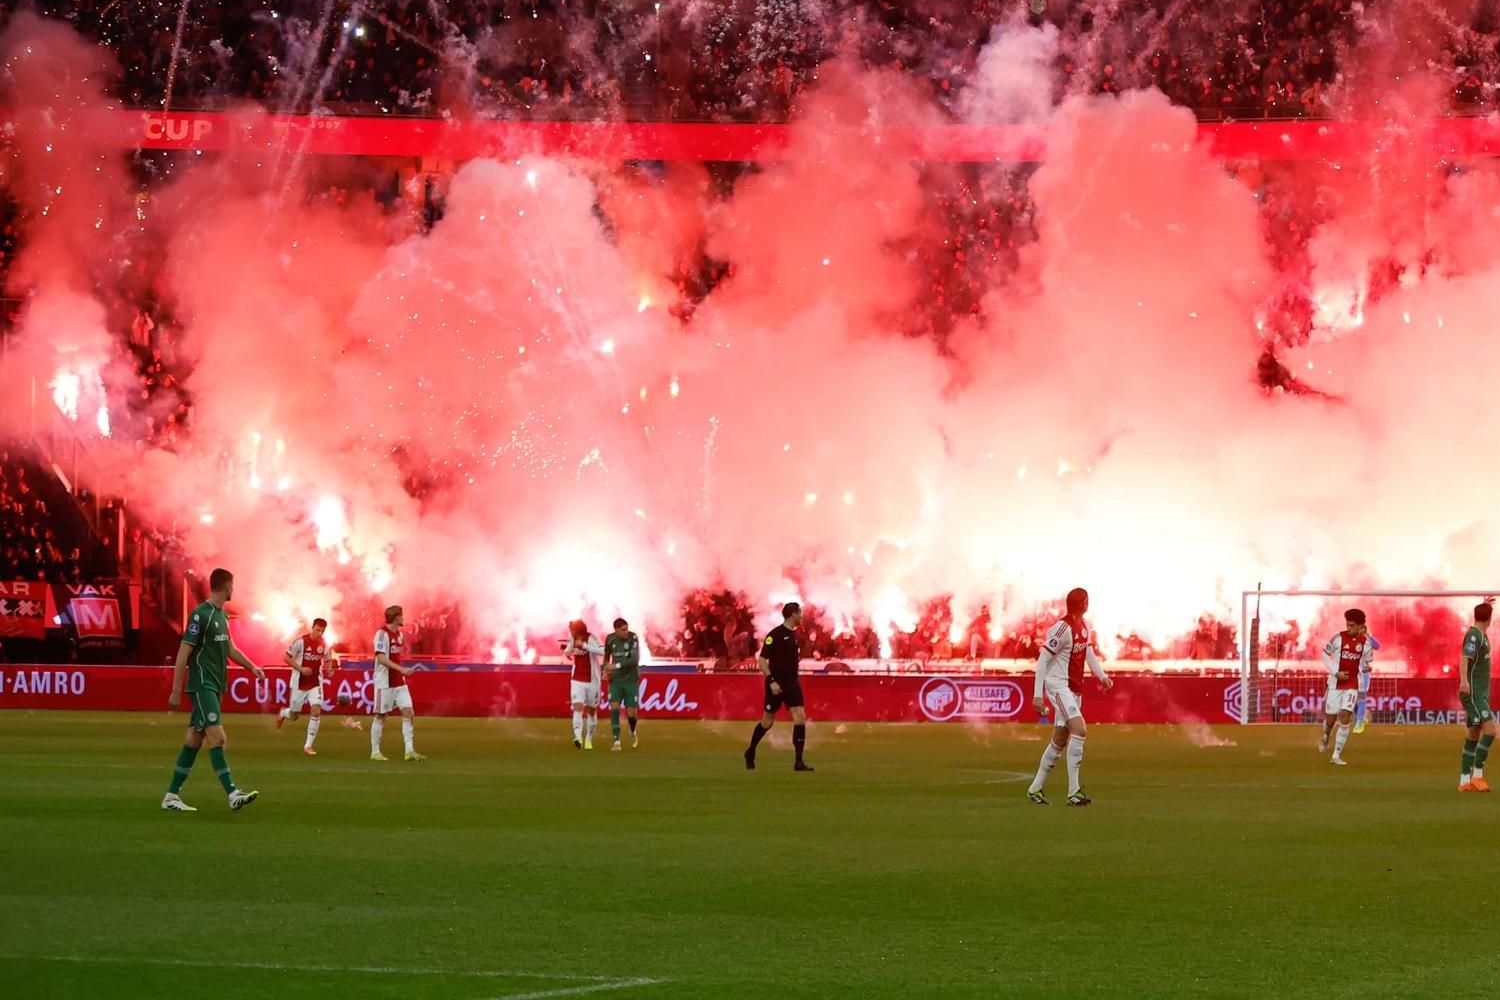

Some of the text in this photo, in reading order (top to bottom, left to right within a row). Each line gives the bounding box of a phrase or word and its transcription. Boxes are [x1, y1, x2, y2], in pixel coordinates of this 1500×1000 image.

[143, 118, 213, 140] CUP
[66, 584, 115, 595] VAK
[79, 604, 117, 630] M
[1395, 711, 1465, 725] ALLSAFE
